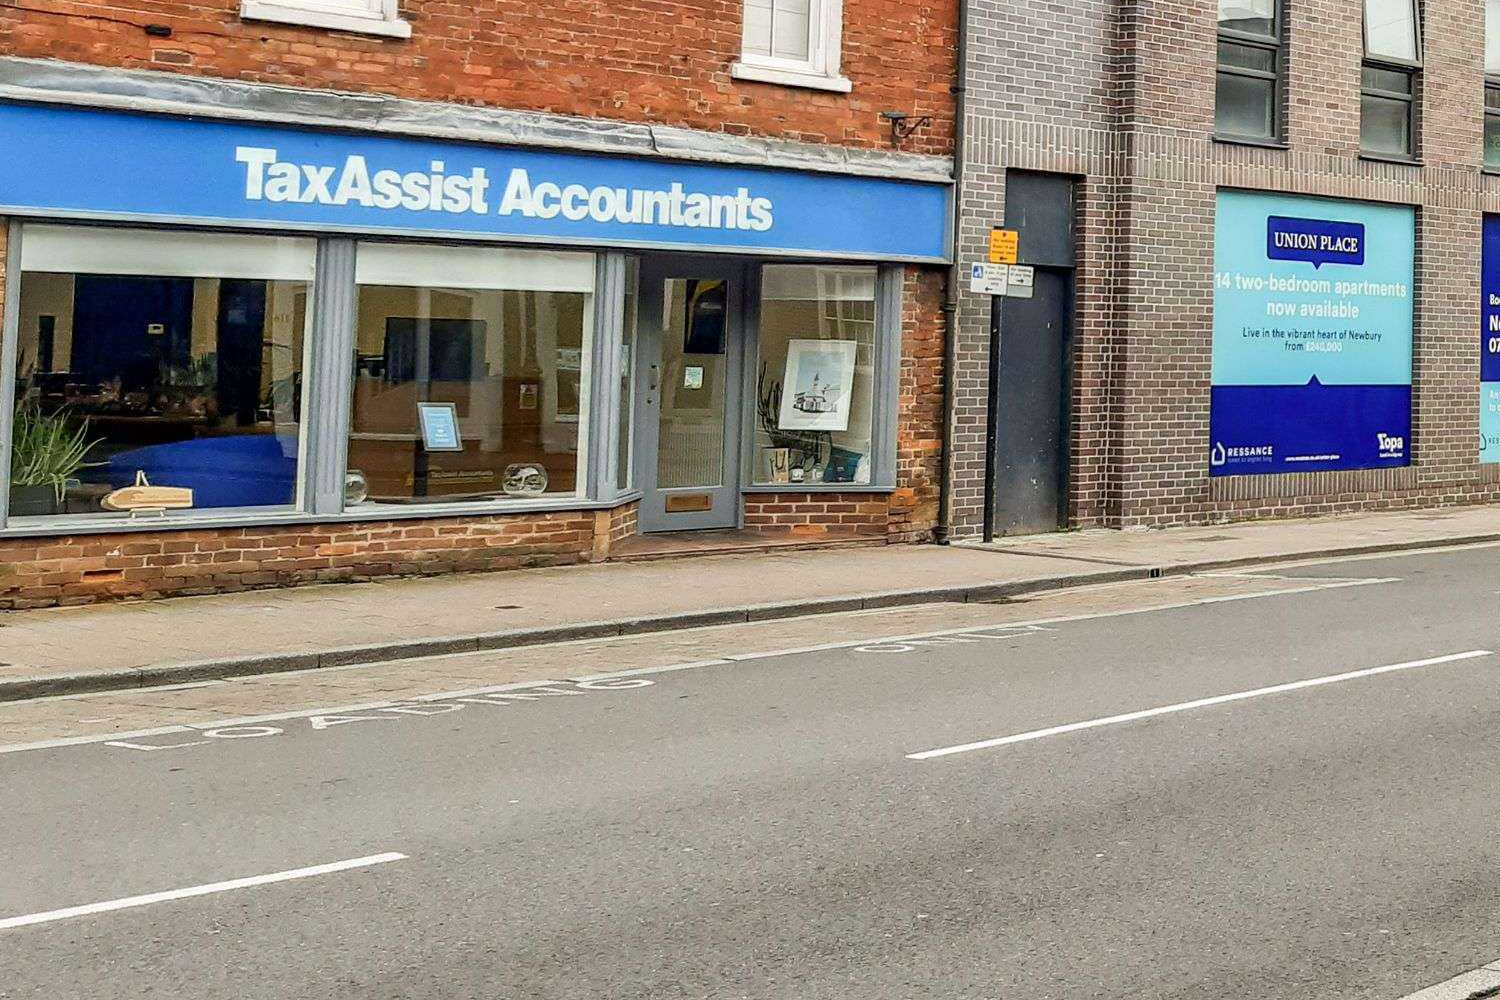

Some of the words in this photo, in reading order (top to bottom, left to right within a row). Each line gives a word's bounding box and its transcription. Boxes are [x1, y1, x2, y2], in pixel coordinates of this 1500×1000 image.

[235, 146, 490, 216] TaxAssist
[498, 168, 774, 232] Accountants
[1274, 231, 1318, 250] UNION
[1320, 233, 1358, 253] PLACE
[1215, 271, 1232, 289] 14
[1235, 274, 1331, 293] two-bedroom
[1334, 279, 1407, 298] apartments
[1266, 301, 1296, 317] now
[1299, 300, 1360, 318] available
[1242, 327, 1260, 338] Live
[1261, 328, 1270, 338] in
[1272, 328, 1285, 338] the
[1287, 328, 1315, 340] vibrant
[1317, 330, 1337, 340] heart
[1339, 329, 1347, 340] of
[1348, 330, 1383, 343] Newbury
[1284, 340, 1304, 351] from
[1227, 446, 1273, 457] RESSANCE
[1376, 432, 1404, 452] Yopa
[103, 678, 656, 752] LOADING
